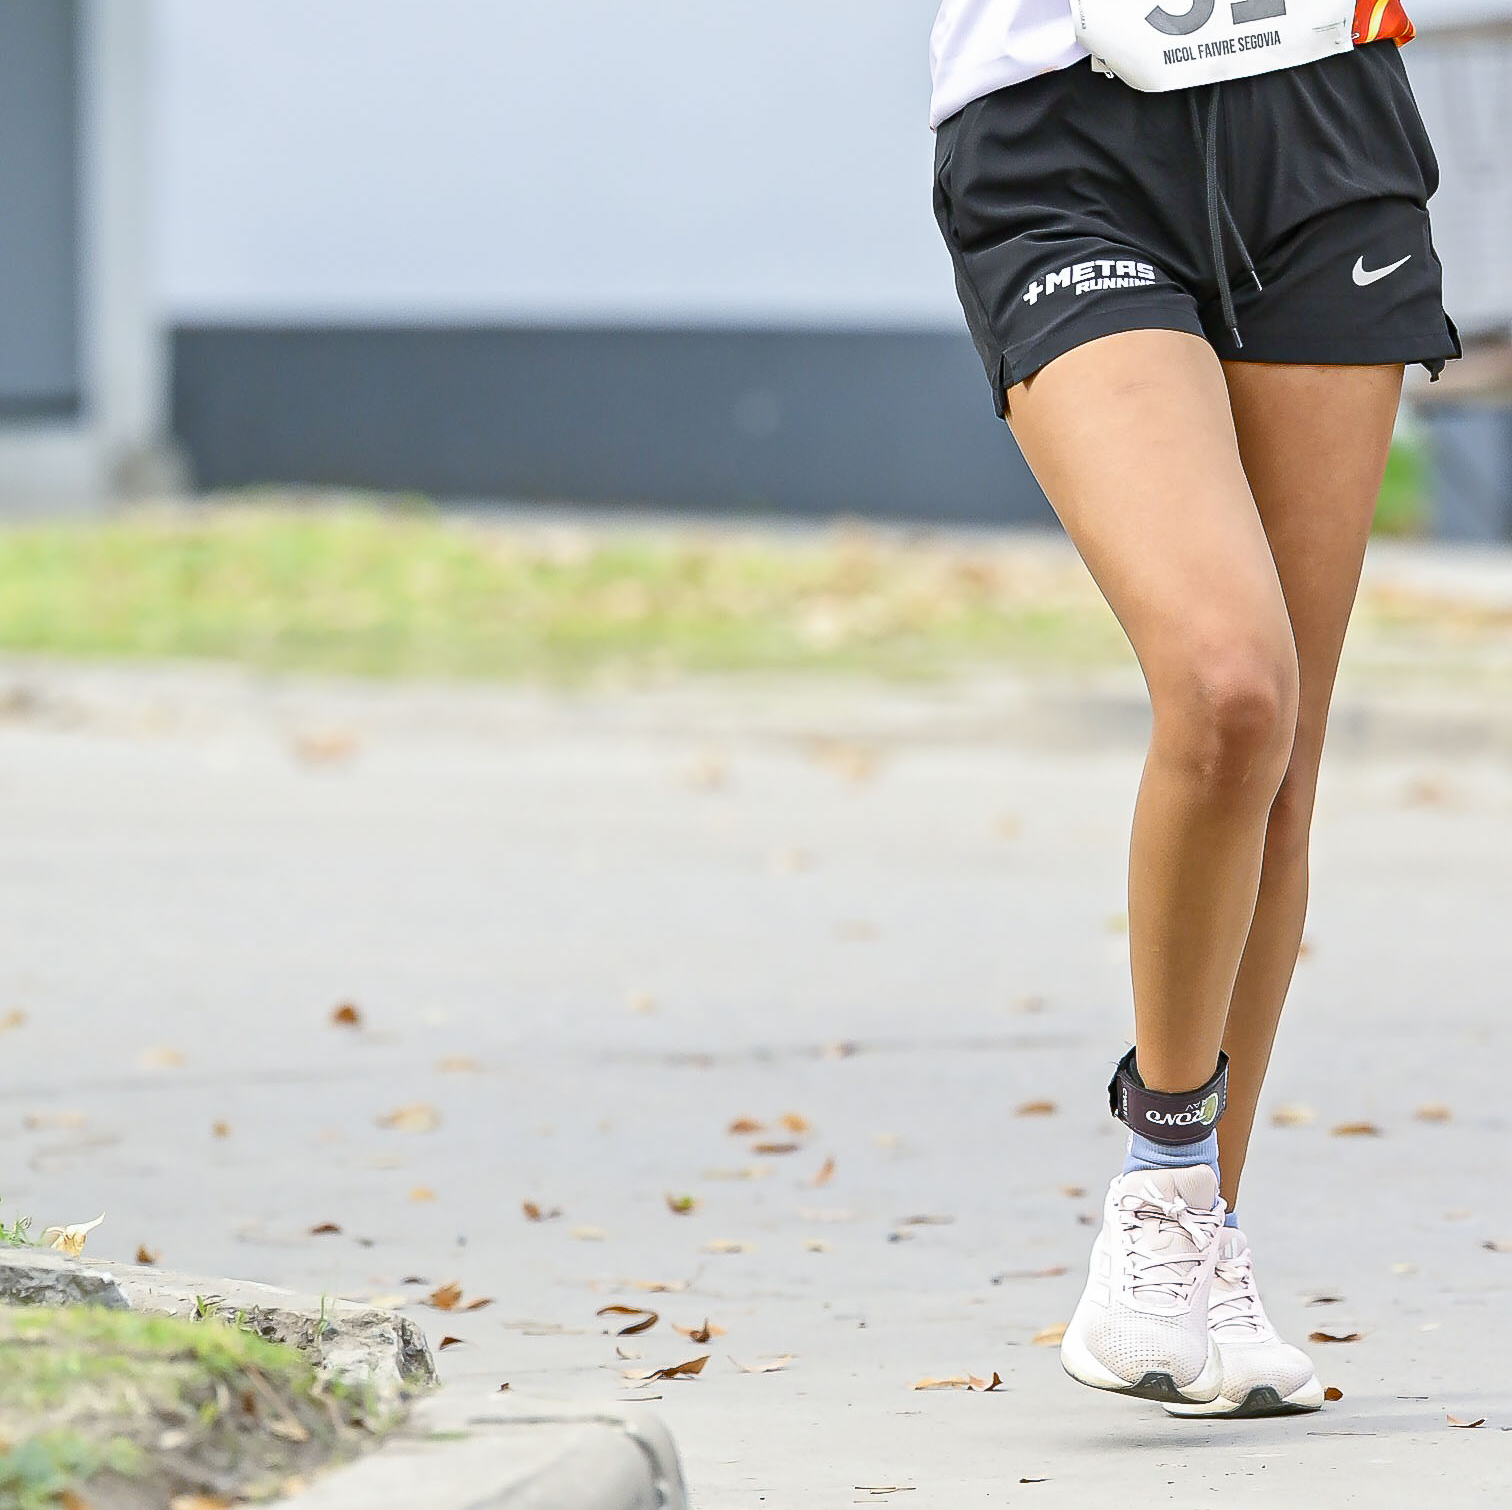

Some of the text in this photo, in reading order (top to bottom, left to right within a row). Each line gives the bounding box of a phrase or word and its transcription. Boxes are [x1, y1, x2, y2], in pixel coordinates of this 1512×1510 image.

[1163, 30, 1282, 66] NICOL FAIVRE SEGOVIA
